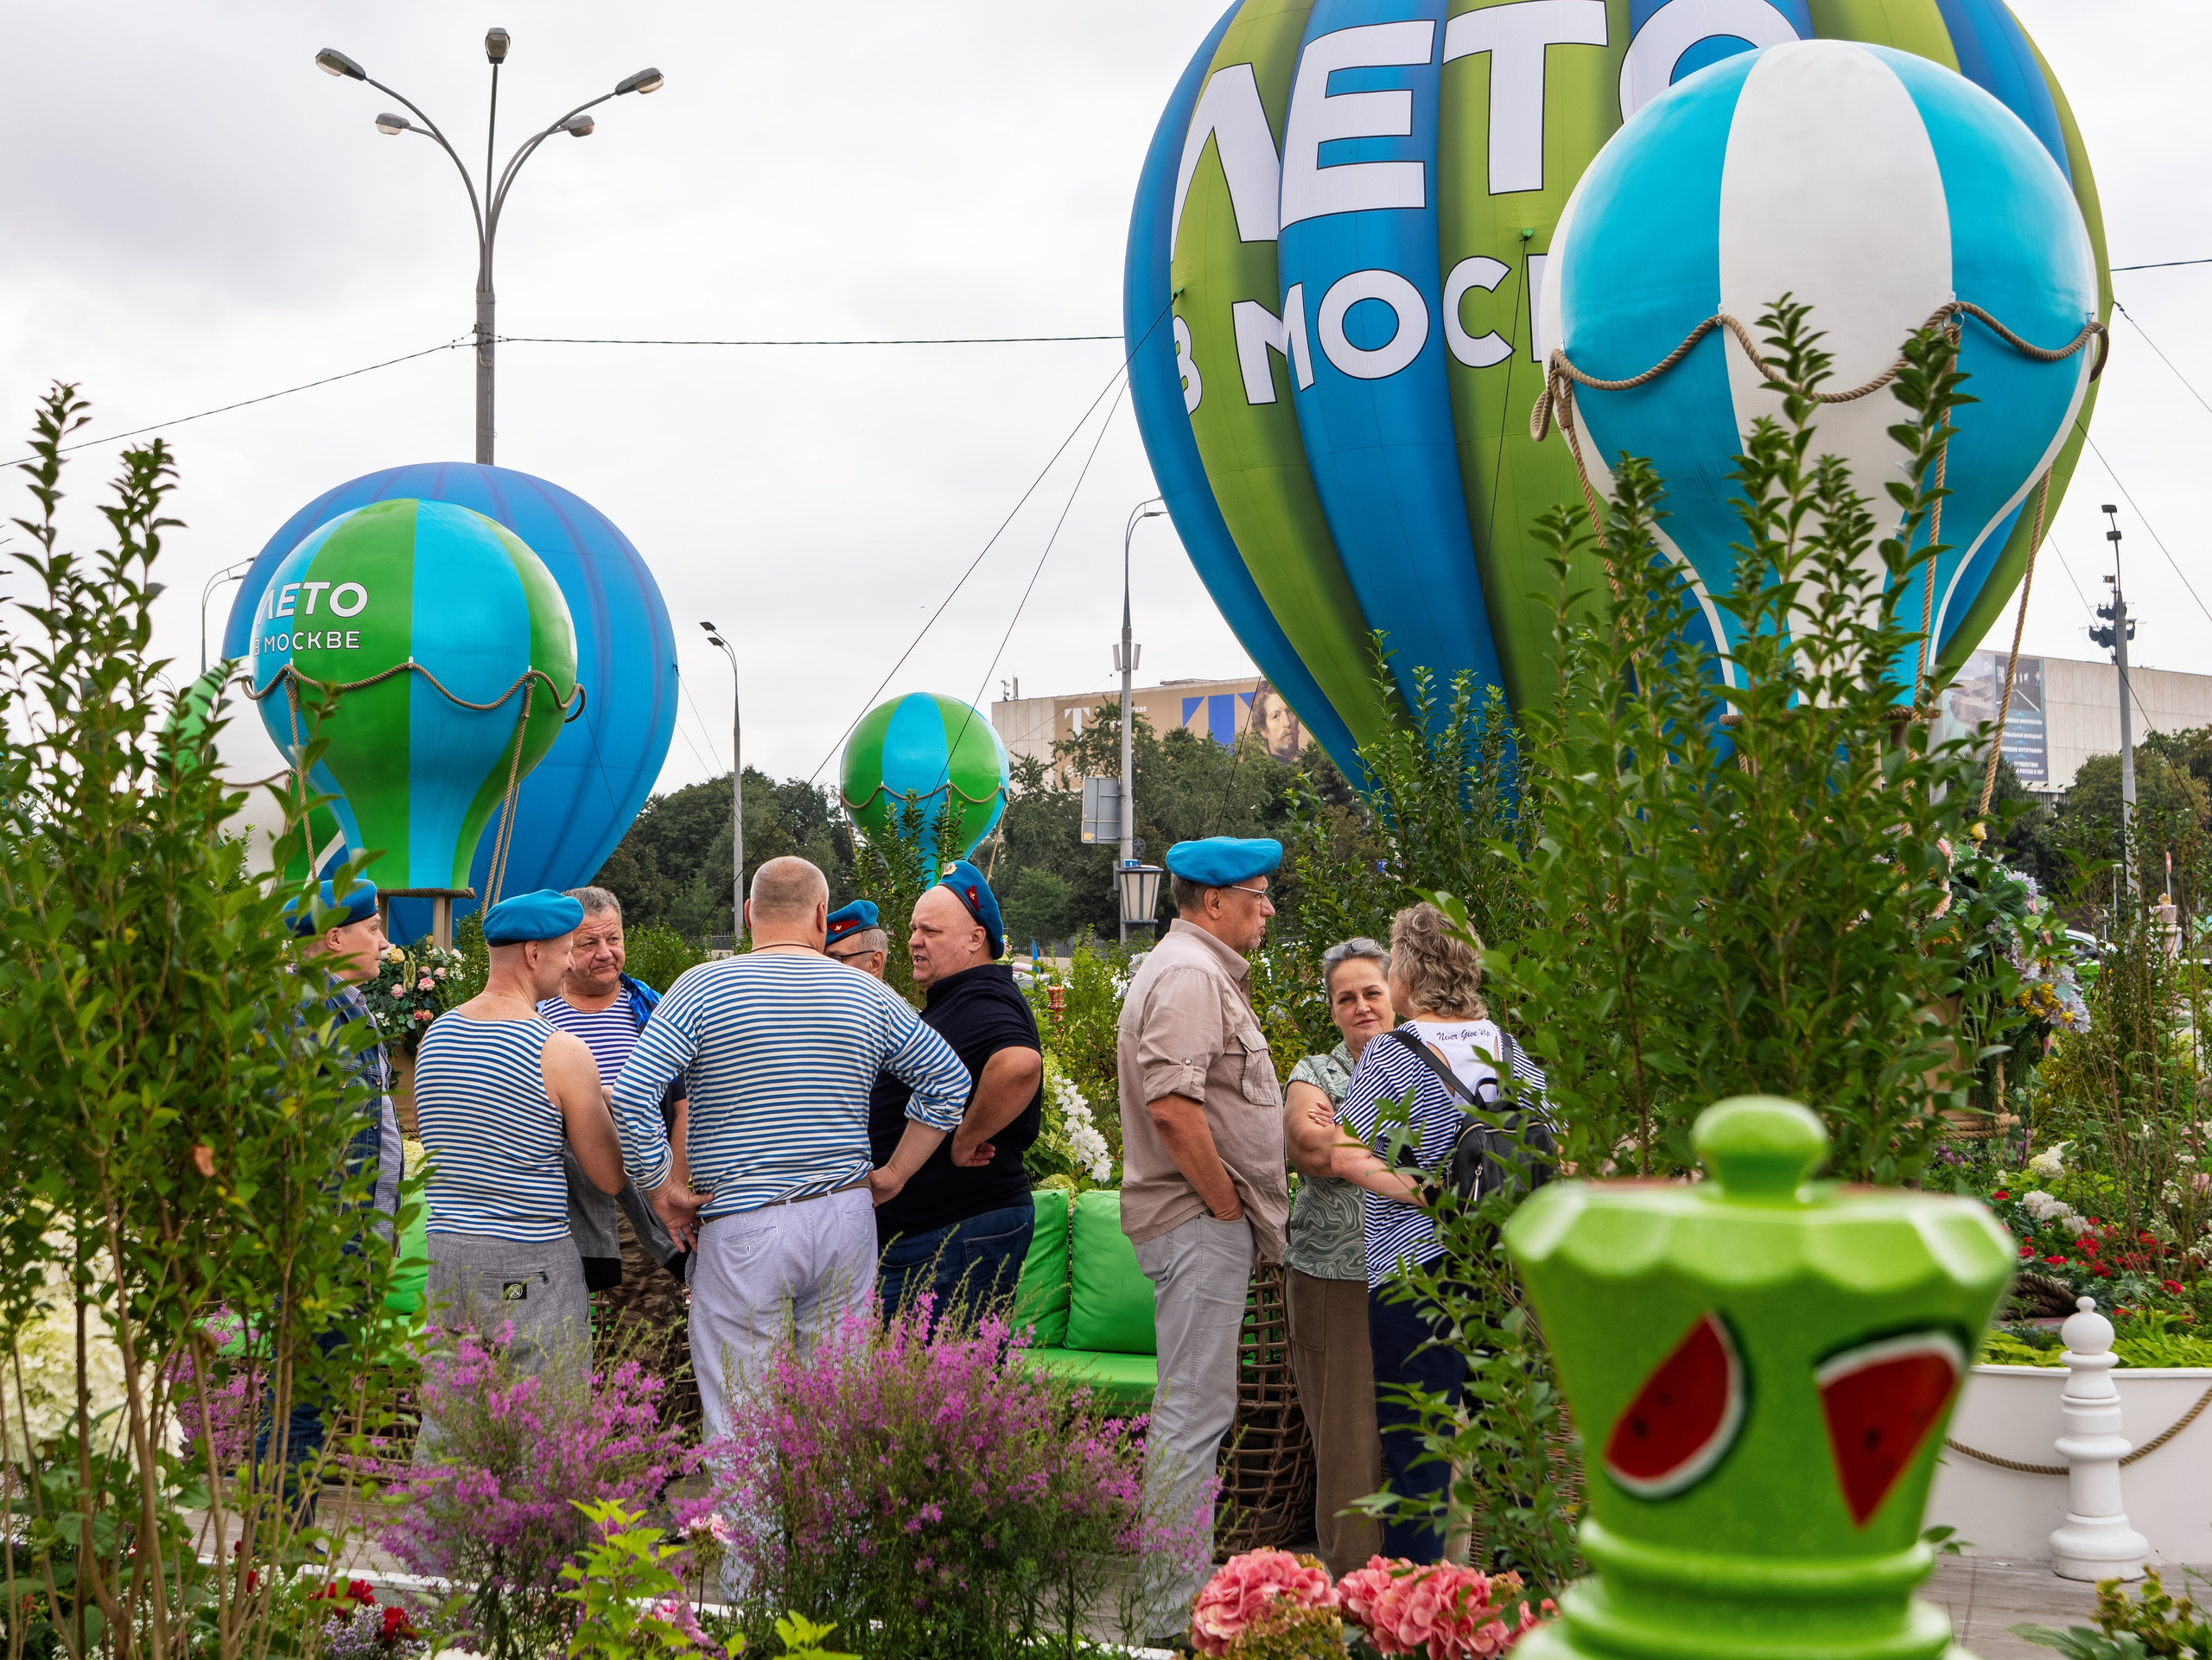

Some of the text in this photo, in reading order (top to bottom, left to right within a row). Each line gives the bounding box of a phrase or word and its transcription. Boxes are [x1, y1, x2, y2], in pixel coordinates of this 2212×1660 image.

[1232, 254, 1546, 405] МОС
[257, 581, 369, 626] ЛЕТО
[254, 630, 360, 657] В МОСКВЕ
[1436, 1032, 1458, 1041] Never
[1460, 1028, 1478, 1041] Give
